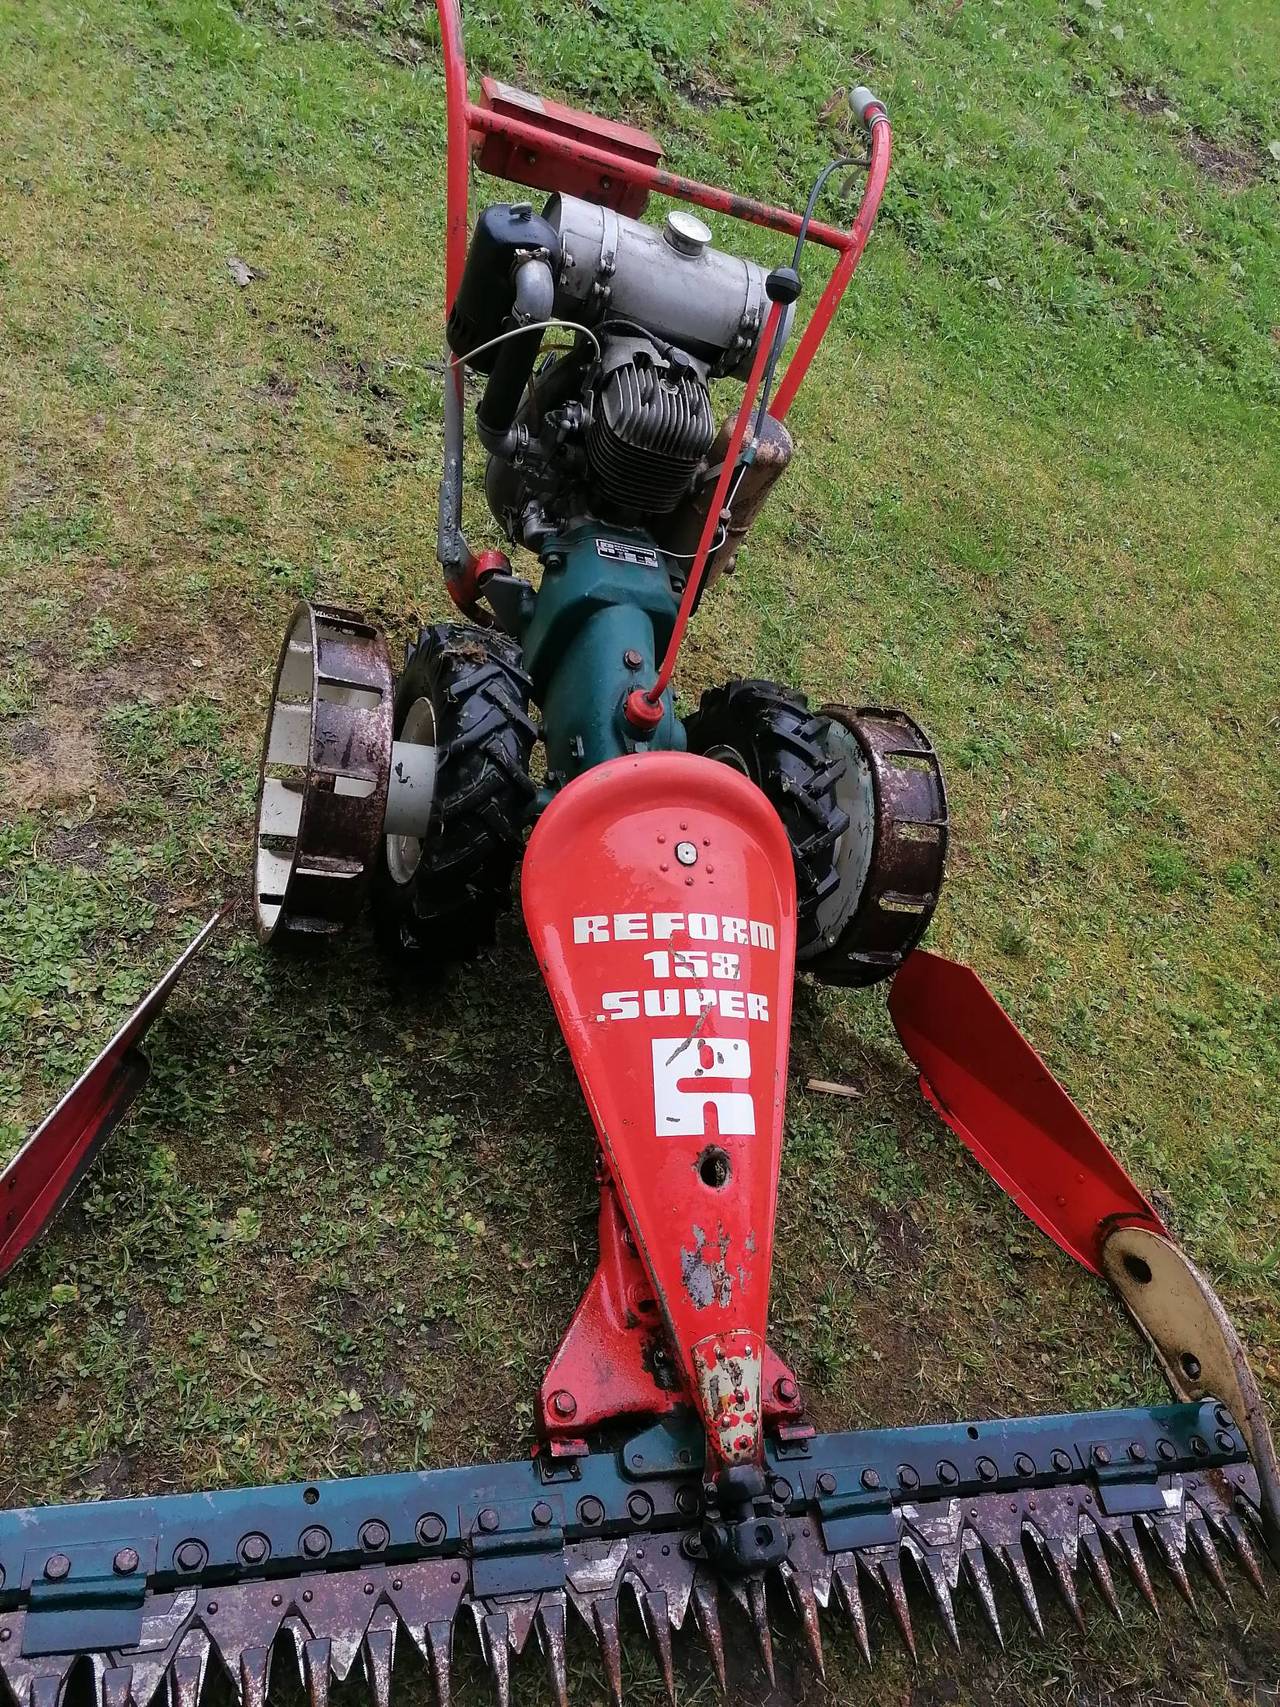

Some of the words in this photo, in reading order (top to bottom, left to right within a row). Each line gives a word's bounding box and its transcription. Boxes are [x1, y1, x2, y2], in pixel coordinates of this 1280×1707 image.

[573, 913, 775, 950] REFORM
[643, 951, 741, 979] 158
[597, 988, 769, 1022] SUPER
